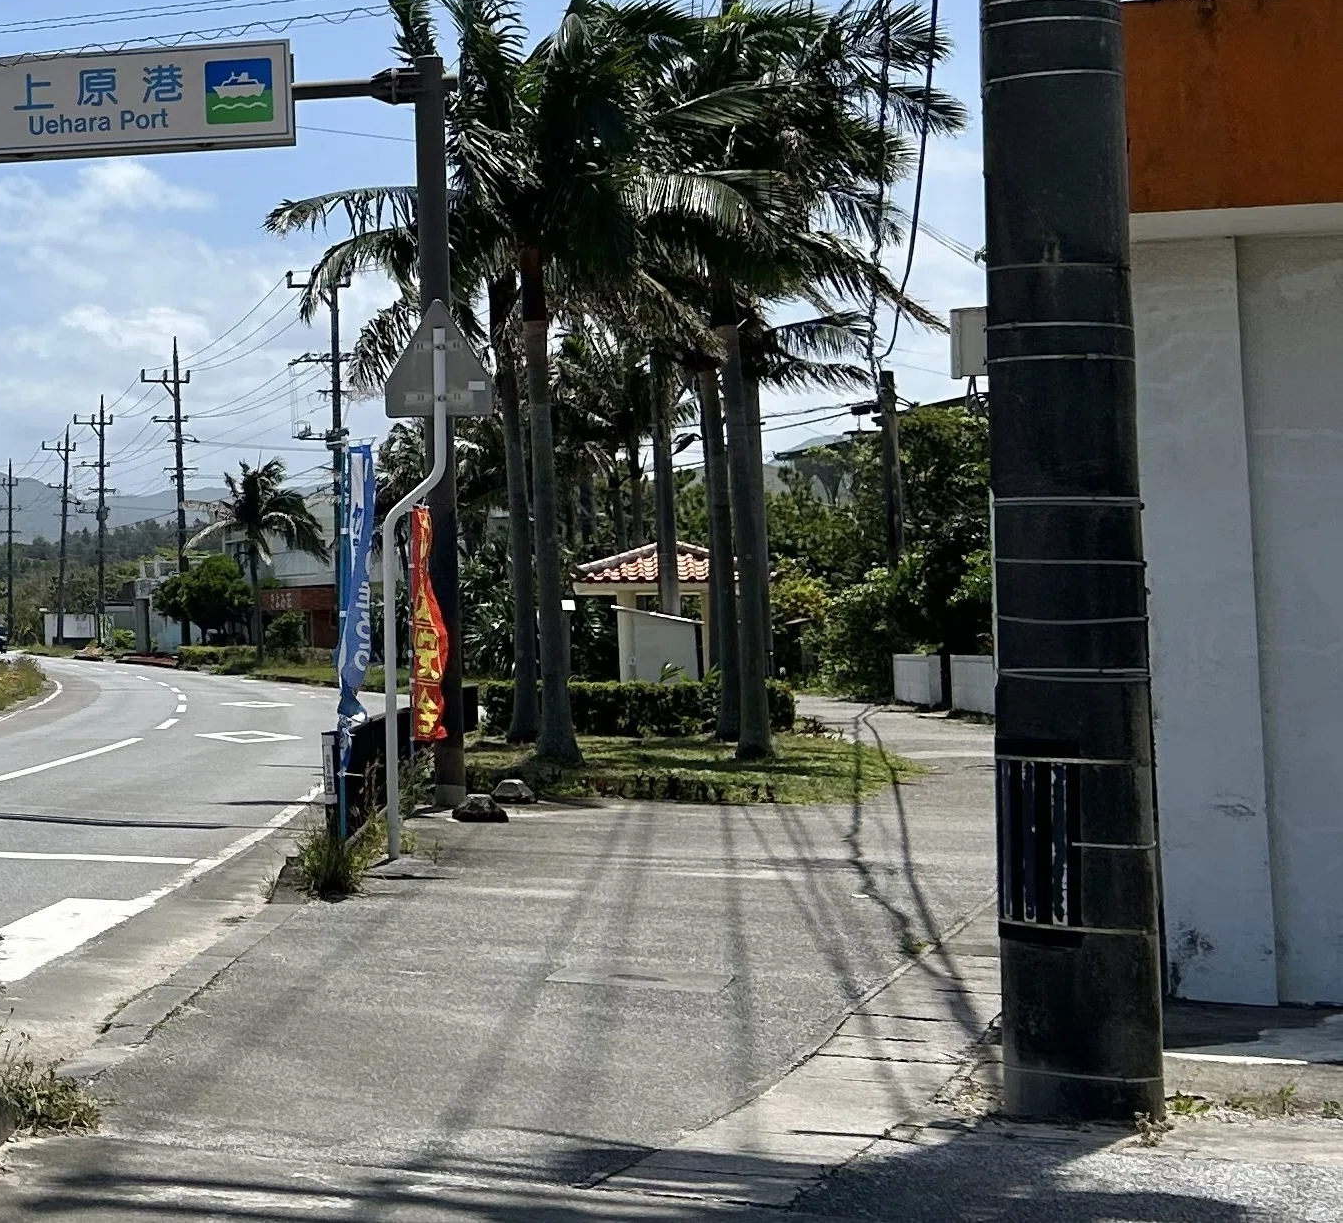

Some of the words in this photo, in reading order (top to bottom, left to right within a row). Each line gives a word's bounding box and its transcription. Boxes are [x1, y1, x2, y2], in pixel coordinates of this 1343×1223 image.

[13, 64, 184, 111] 上原港
[28, 114, 111, 136] Uehara
[120, 107, 169, 130] Port
